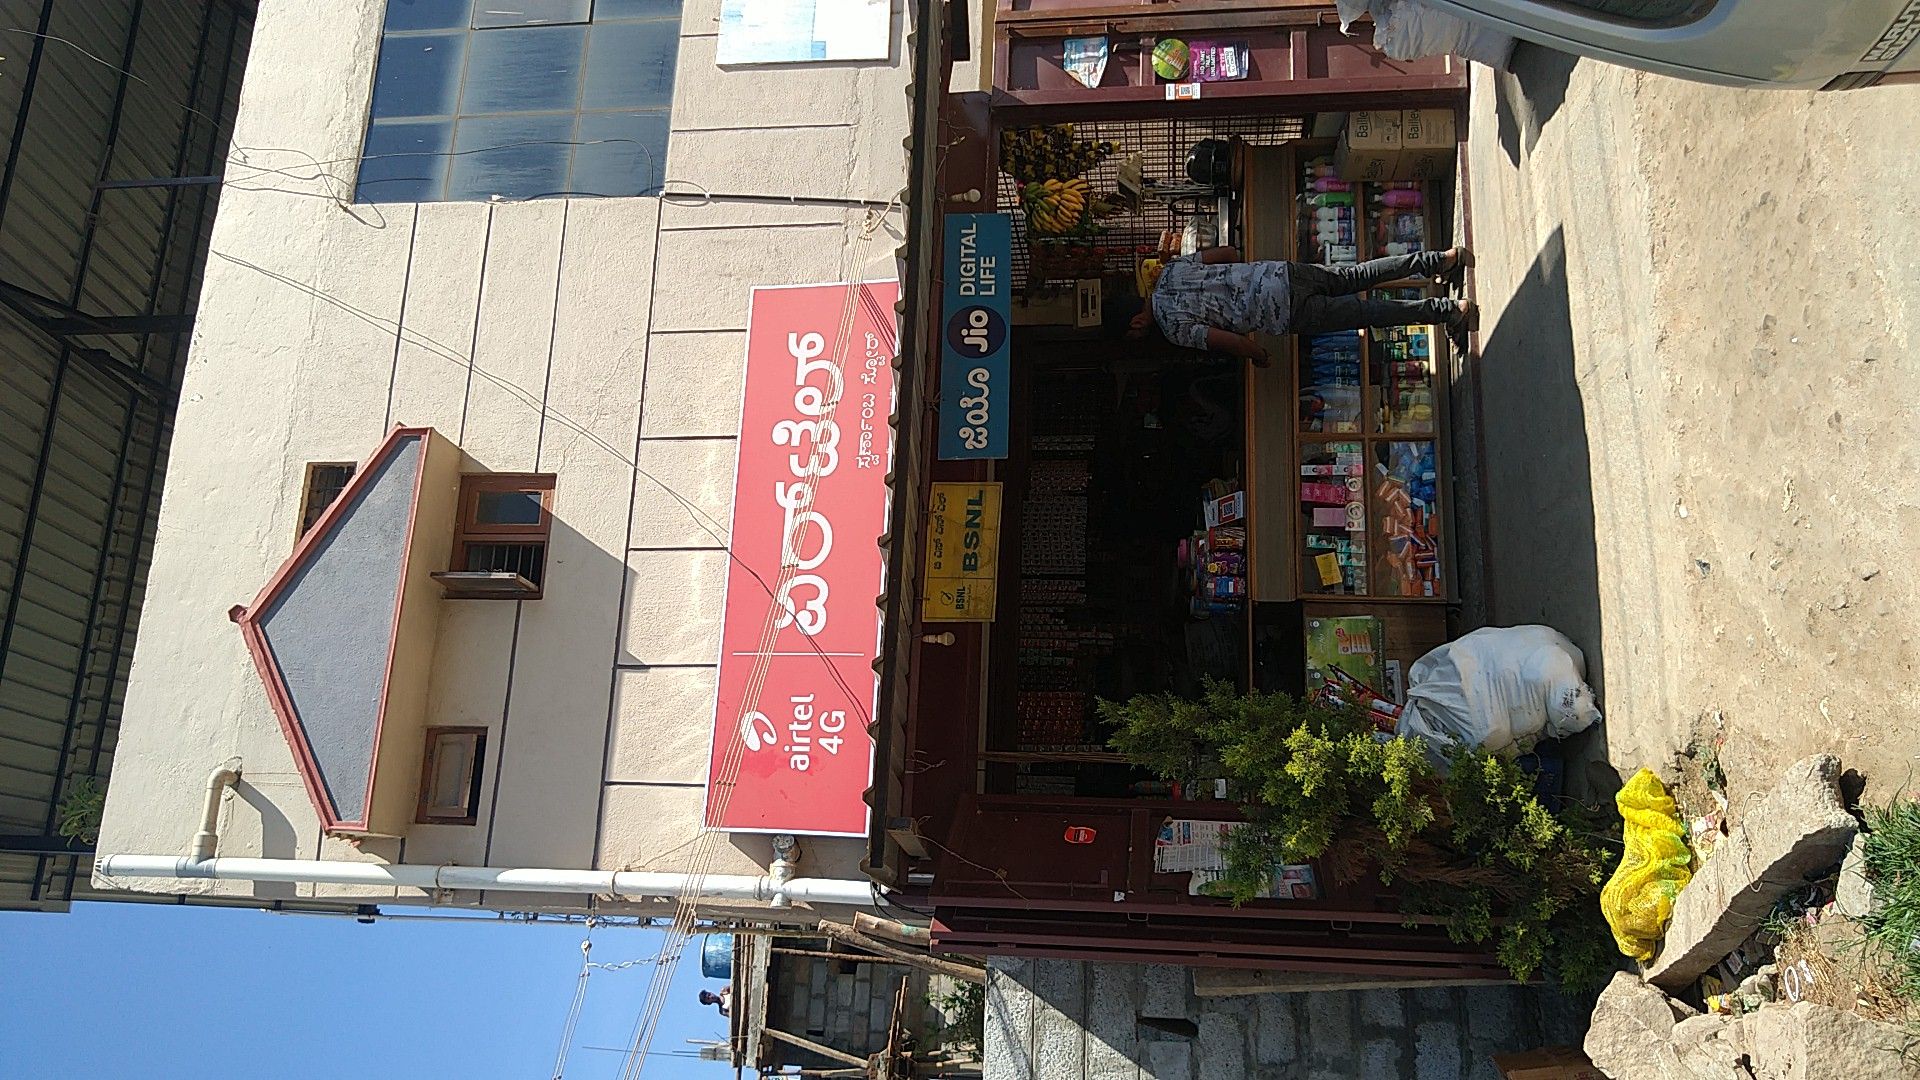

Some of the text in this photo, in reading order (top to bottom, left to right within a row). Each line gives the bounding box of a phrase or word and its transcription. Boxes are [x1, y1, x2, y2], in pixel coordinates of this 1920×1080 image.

[1356, 112, 1368, 138] Baille
[959, 223, 977, 296] DIGITAL
[980, 256, 996, 296] LIFE
[961, 309, 988, 353] Jio
[962, 489, 983, 572] BSNL
[955, 586, 966, 609] BSNL
[784, 693, 814, 771] airtel
[818, 710, 846, 755] 4G
